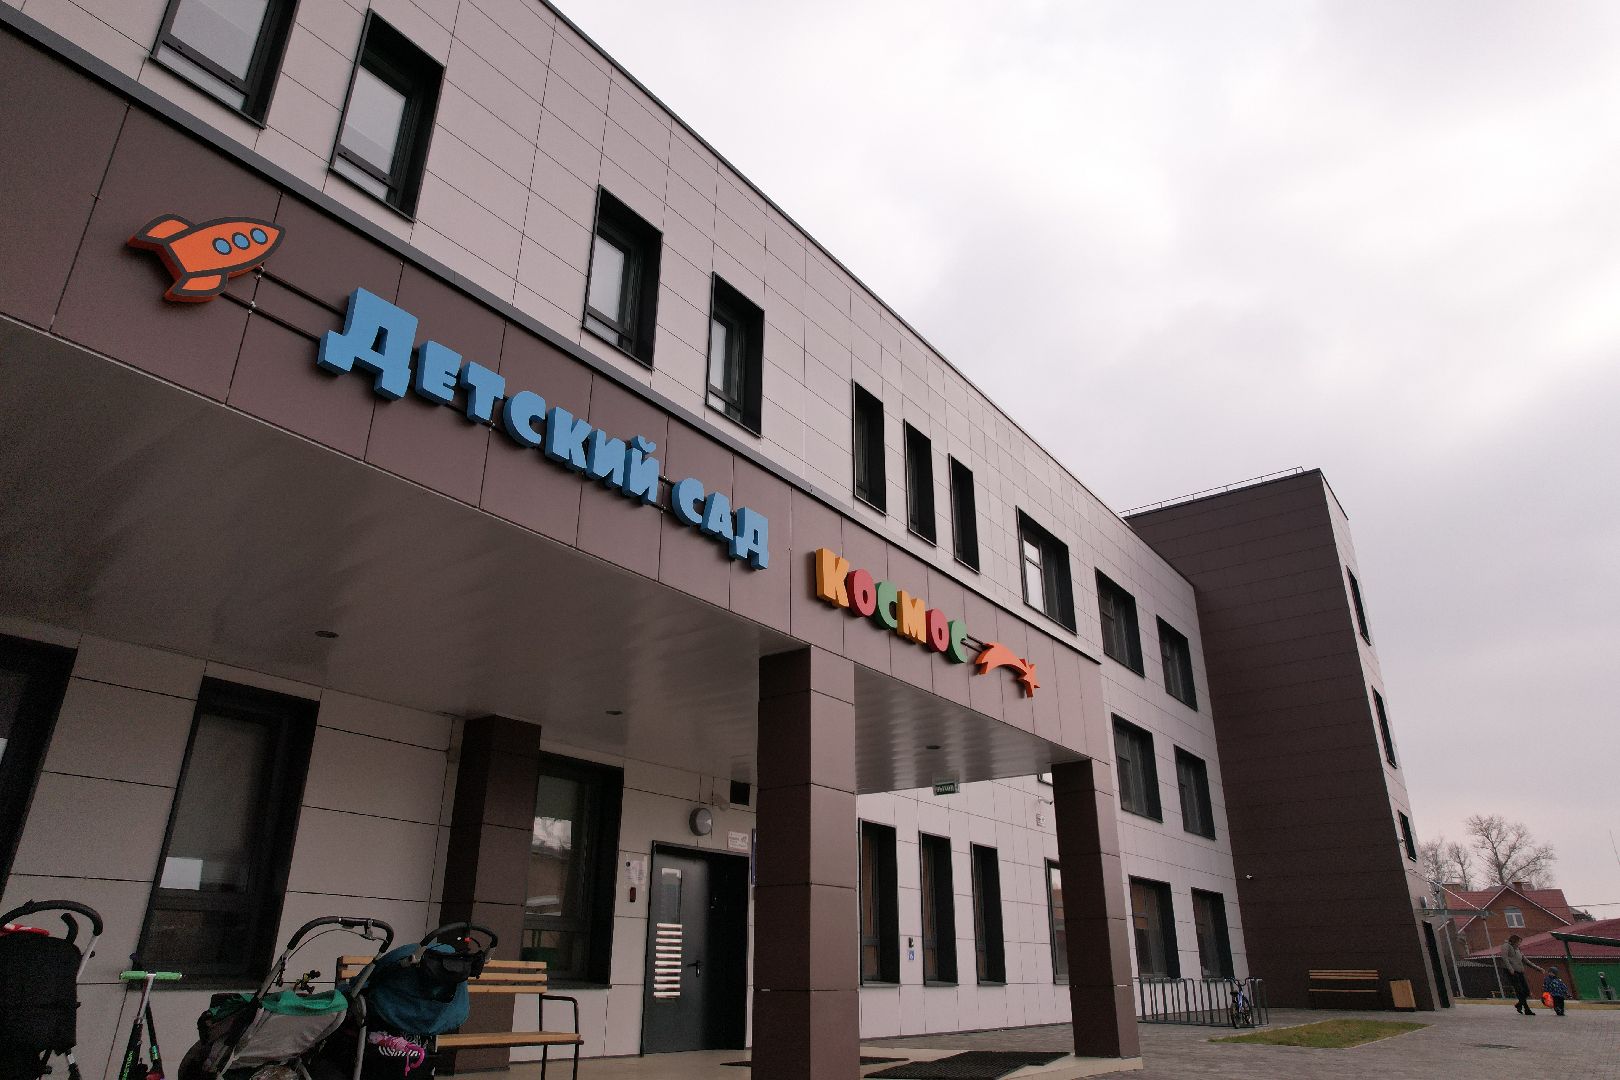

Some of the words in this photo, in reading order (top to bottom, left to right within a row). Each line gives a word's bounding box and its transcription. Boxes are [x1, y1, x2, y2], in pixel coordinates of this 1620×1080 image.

[317, 287, 659, 506] ДЕТСКИЙ
[671, 477, 769, 570] САД
[815, 547, 968, 664] КОСМОС
